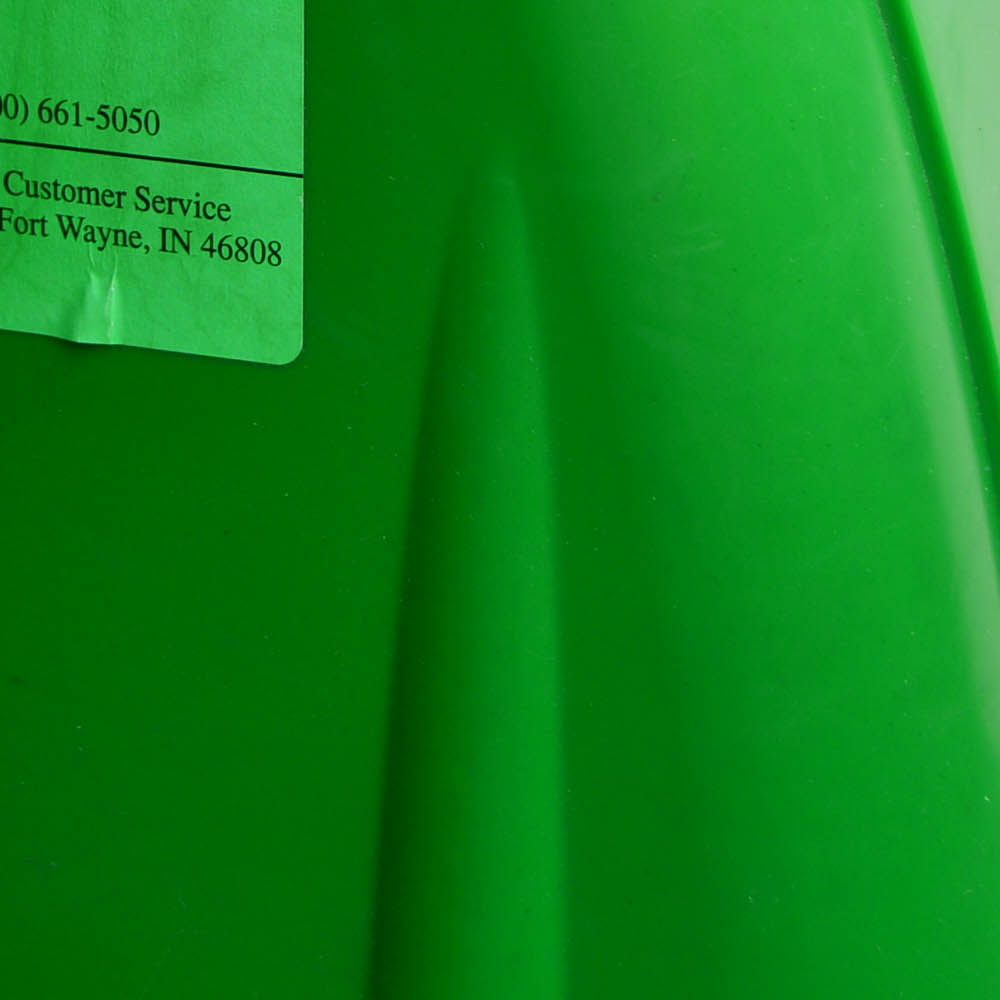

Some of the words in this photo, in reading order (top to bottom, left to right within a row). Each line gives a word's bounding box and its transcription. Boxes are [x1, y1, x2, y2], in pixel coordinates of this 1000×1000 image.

[37, 97, 161, 137] 661-5050
[2, 169, 128, 209] Customer
[133, 185, 232, 223] Service
[55, 213, 151, 255] Wayne,
[159, 226, 193, 255] IN
[199, 232, 283, 267] 46808
